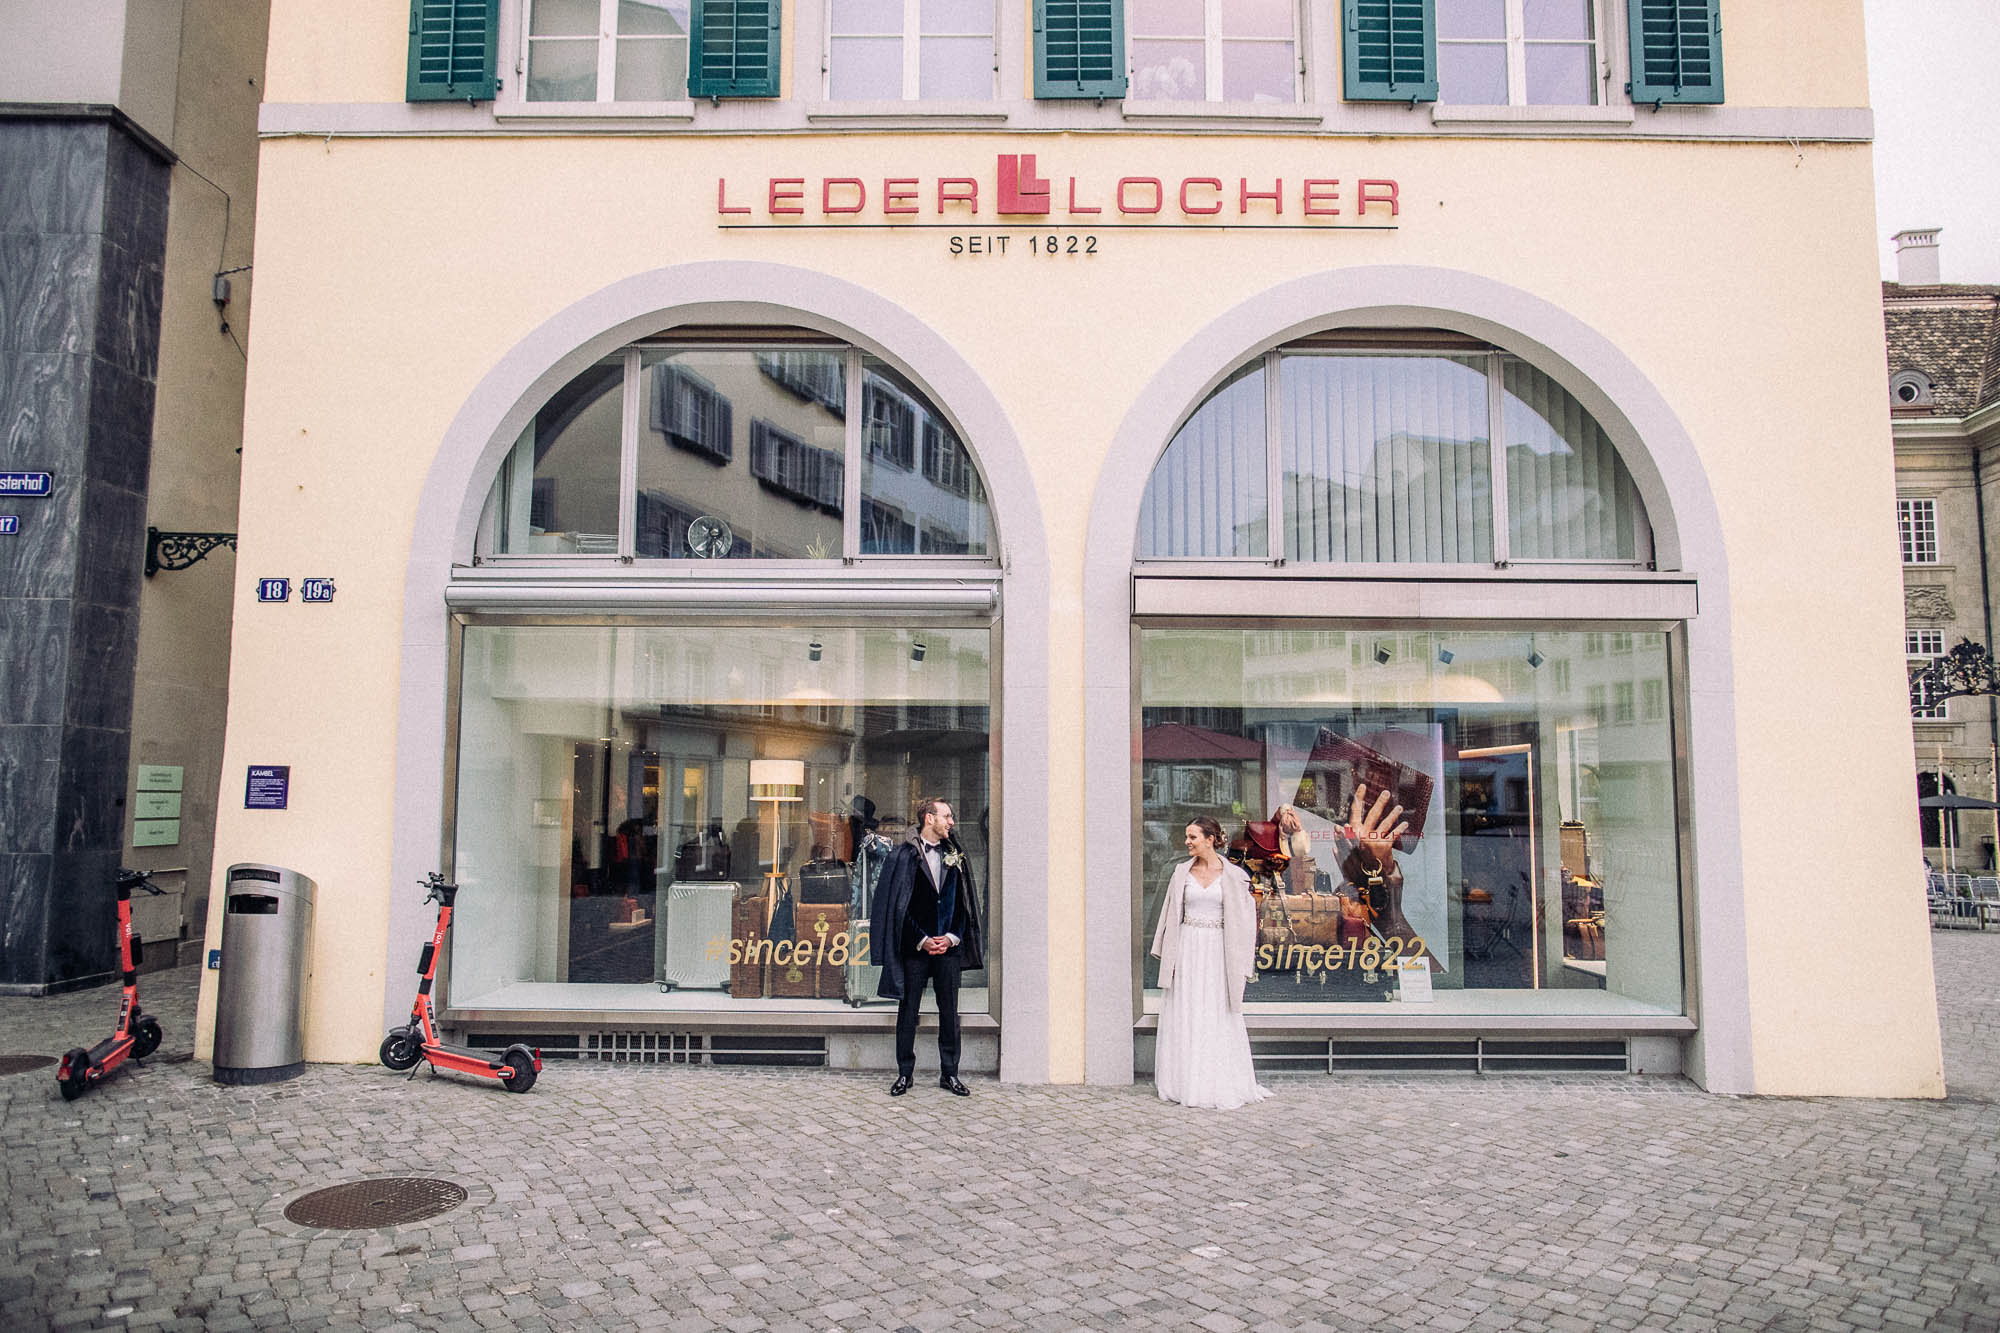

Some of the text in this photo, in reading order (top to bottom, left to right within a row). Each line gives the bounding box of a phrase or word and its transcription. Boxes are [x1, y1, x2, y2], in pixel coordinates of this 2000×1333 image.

[718, 177, 979, 214] LEDER
[1069, 177, 1399, 216] LOCHER
[949, 235, 1099, 255] SEIT 1822
[266, 581, 283, 598] 18
[306, 581, 330, 599] 19a
[704, 931, 870, 966] #since182
[1256, 936, 1427, 971] since1822
